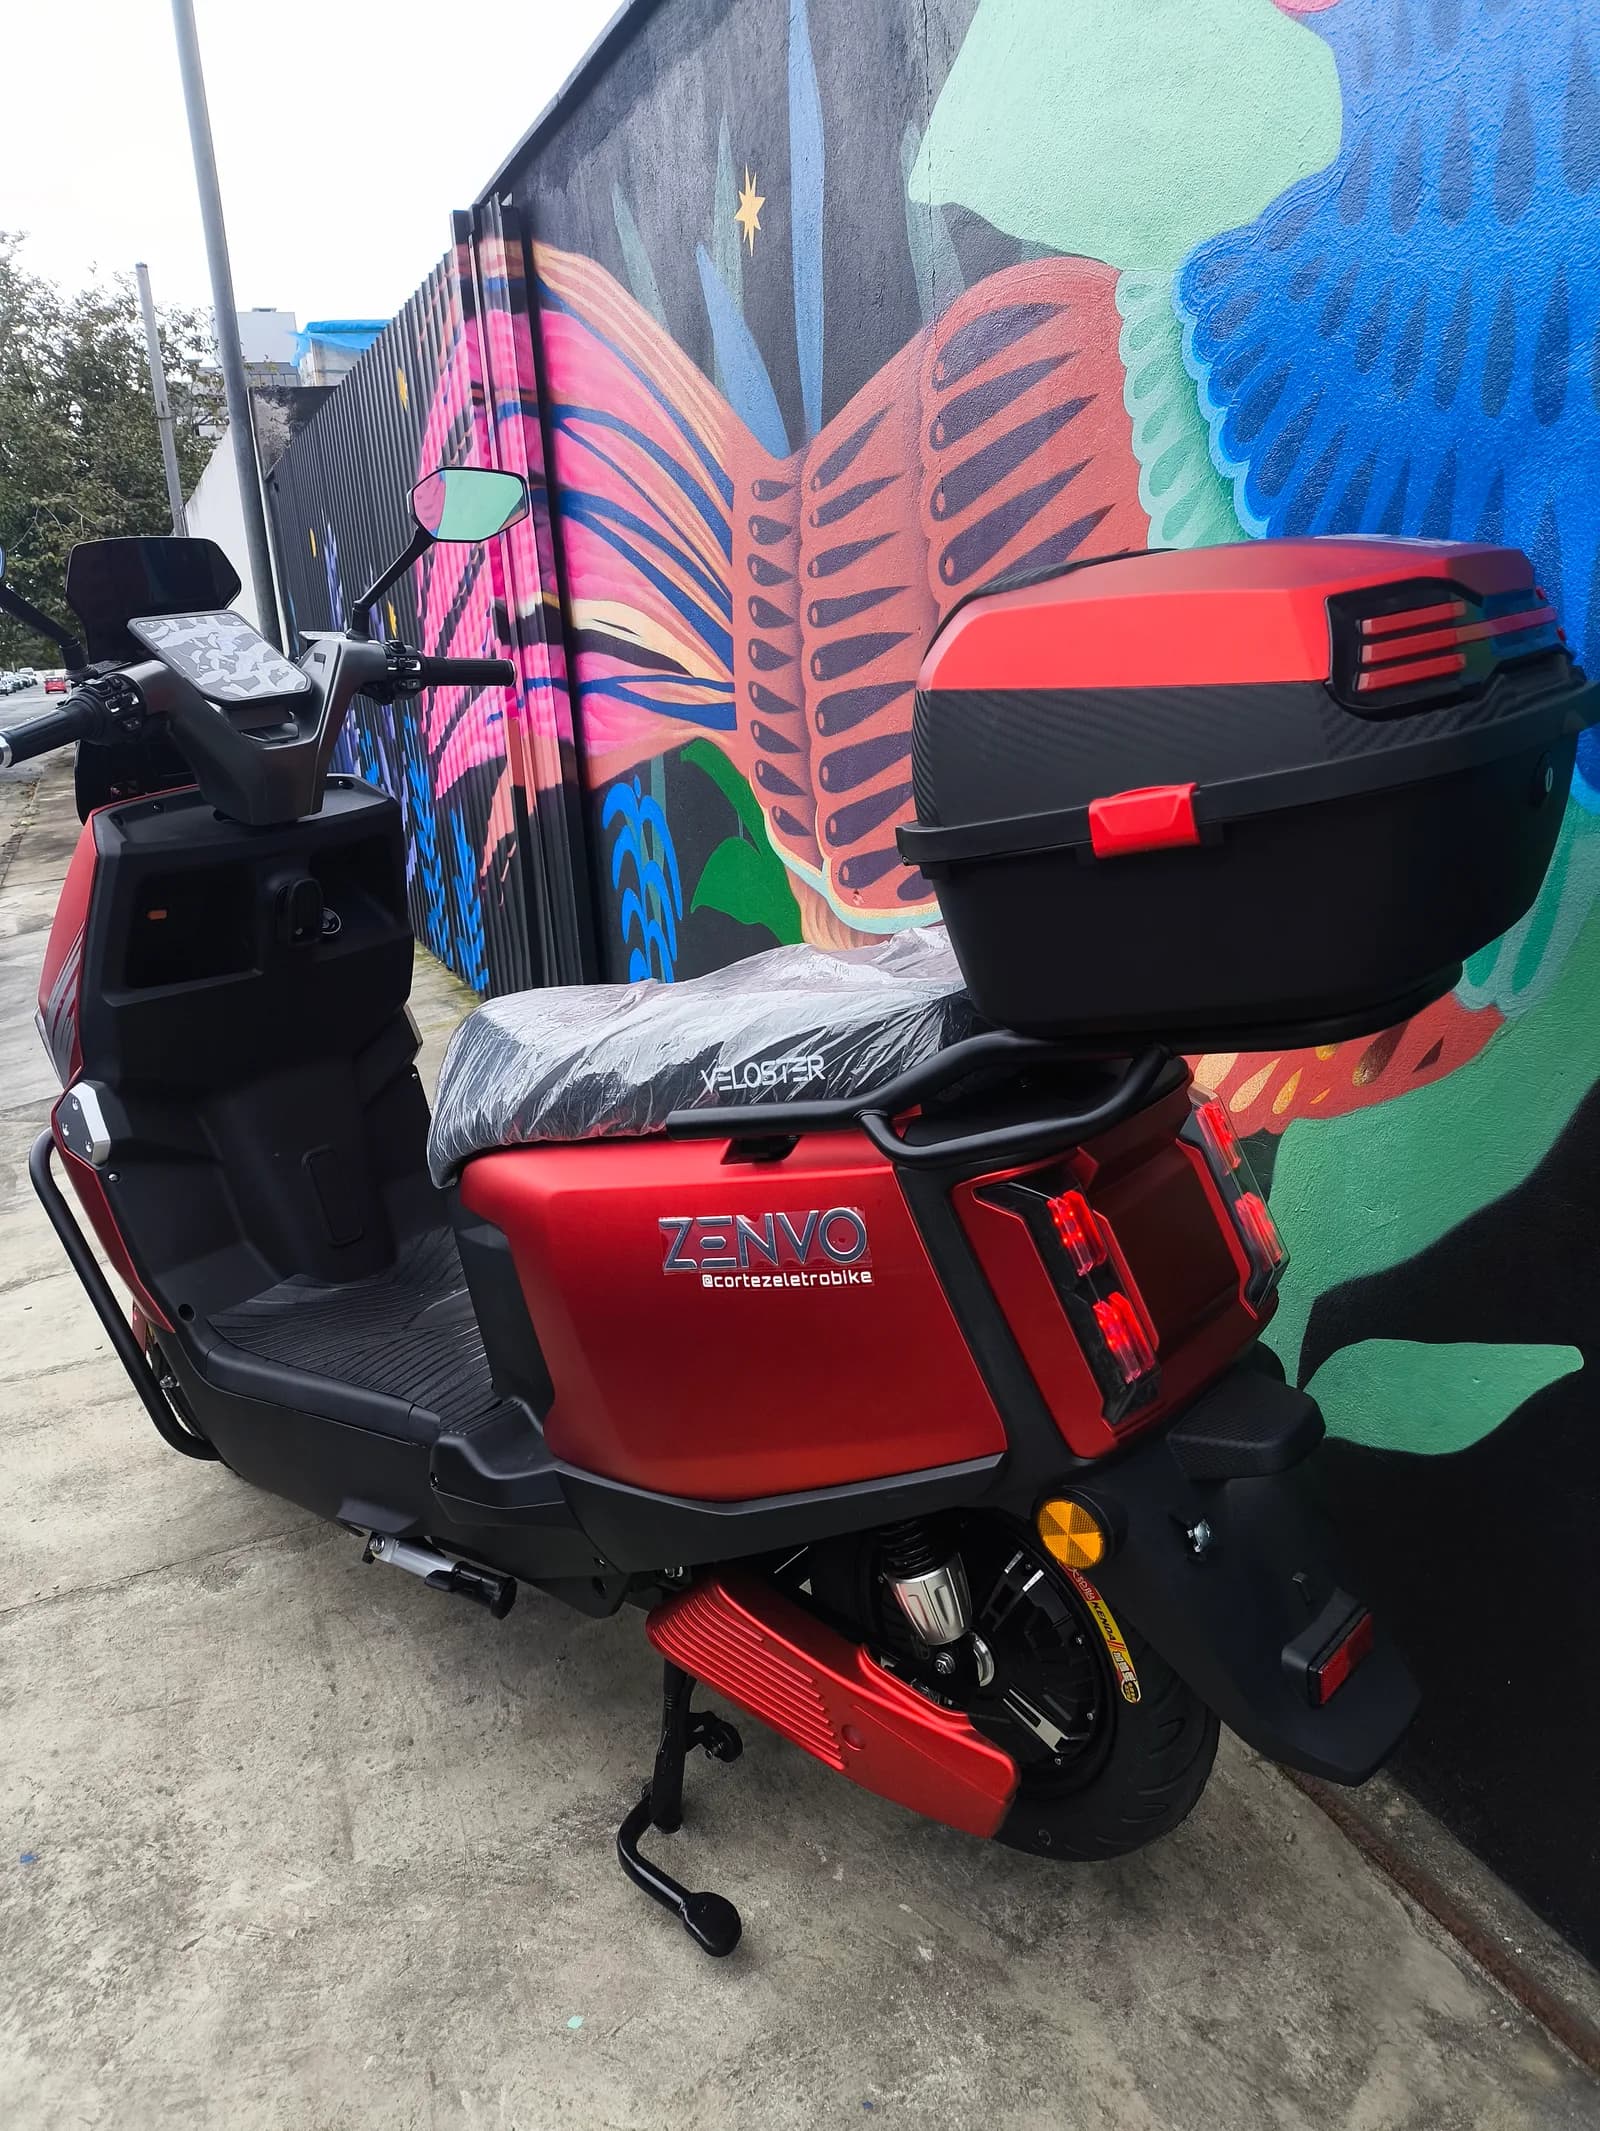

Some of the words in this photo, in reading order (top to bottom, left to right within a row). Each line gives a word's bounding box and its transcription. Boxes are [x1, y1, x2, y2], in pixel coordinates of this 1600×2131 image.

[701, 1055, 825, 1093] VELOSTER
[658, 1207, 867, 1271] ZENVO
[702, 1270, 873, 1288] @cortezeletrobike
[1092, 1601, 1117, 1641] KENDA
